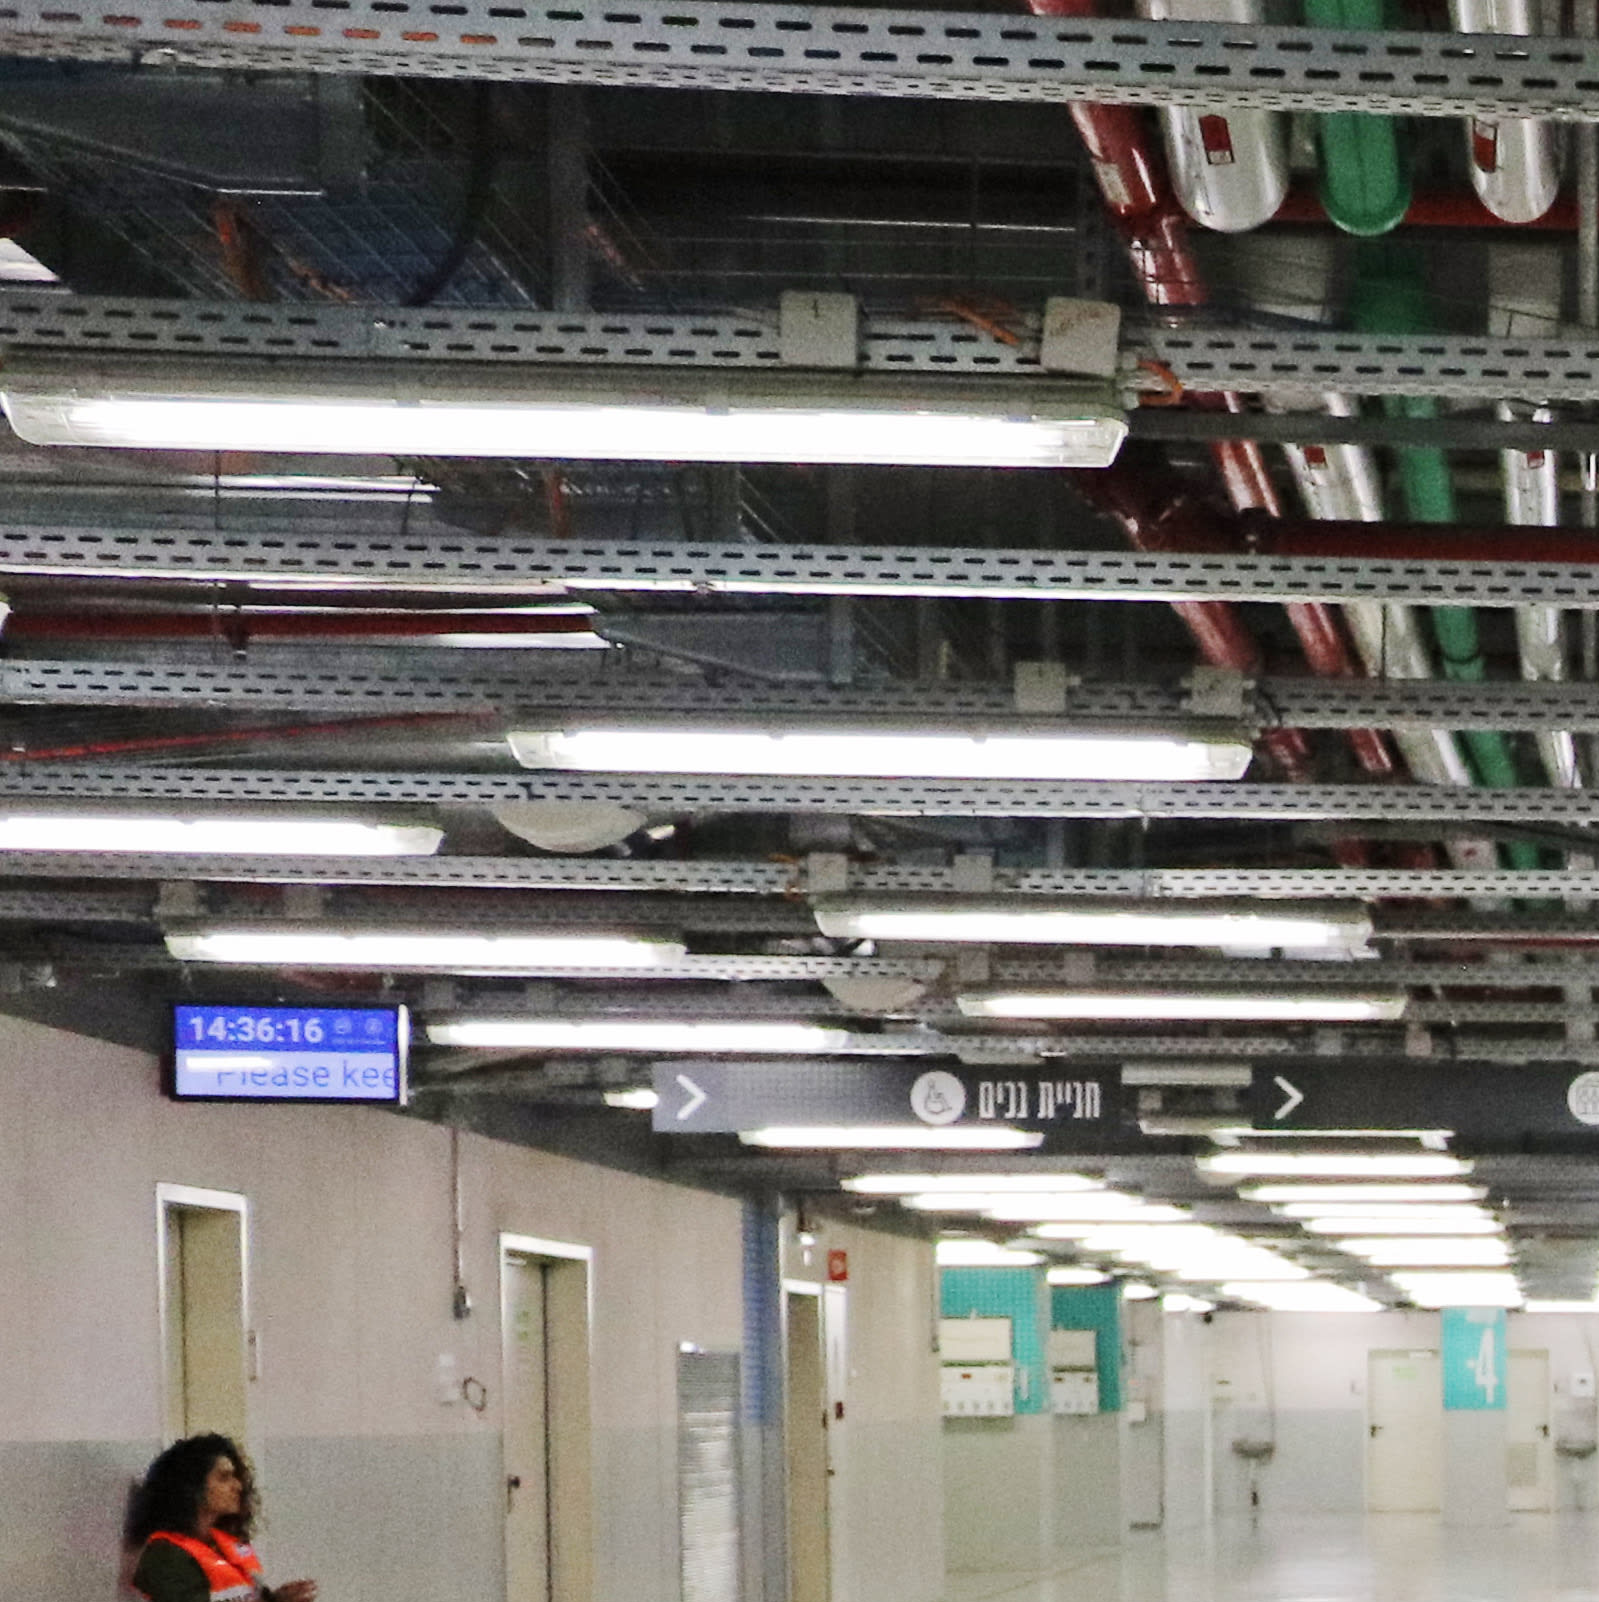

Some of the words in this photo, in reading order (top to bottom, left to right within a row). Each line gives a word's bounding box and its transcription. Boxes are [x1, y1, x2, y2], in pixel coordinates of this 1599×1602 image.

[190, 1016, 325, 1043] 14:36:16
[978, 1081, 1028, 1119] נכים
[1037, 1081, 1100, 1119] חניית
